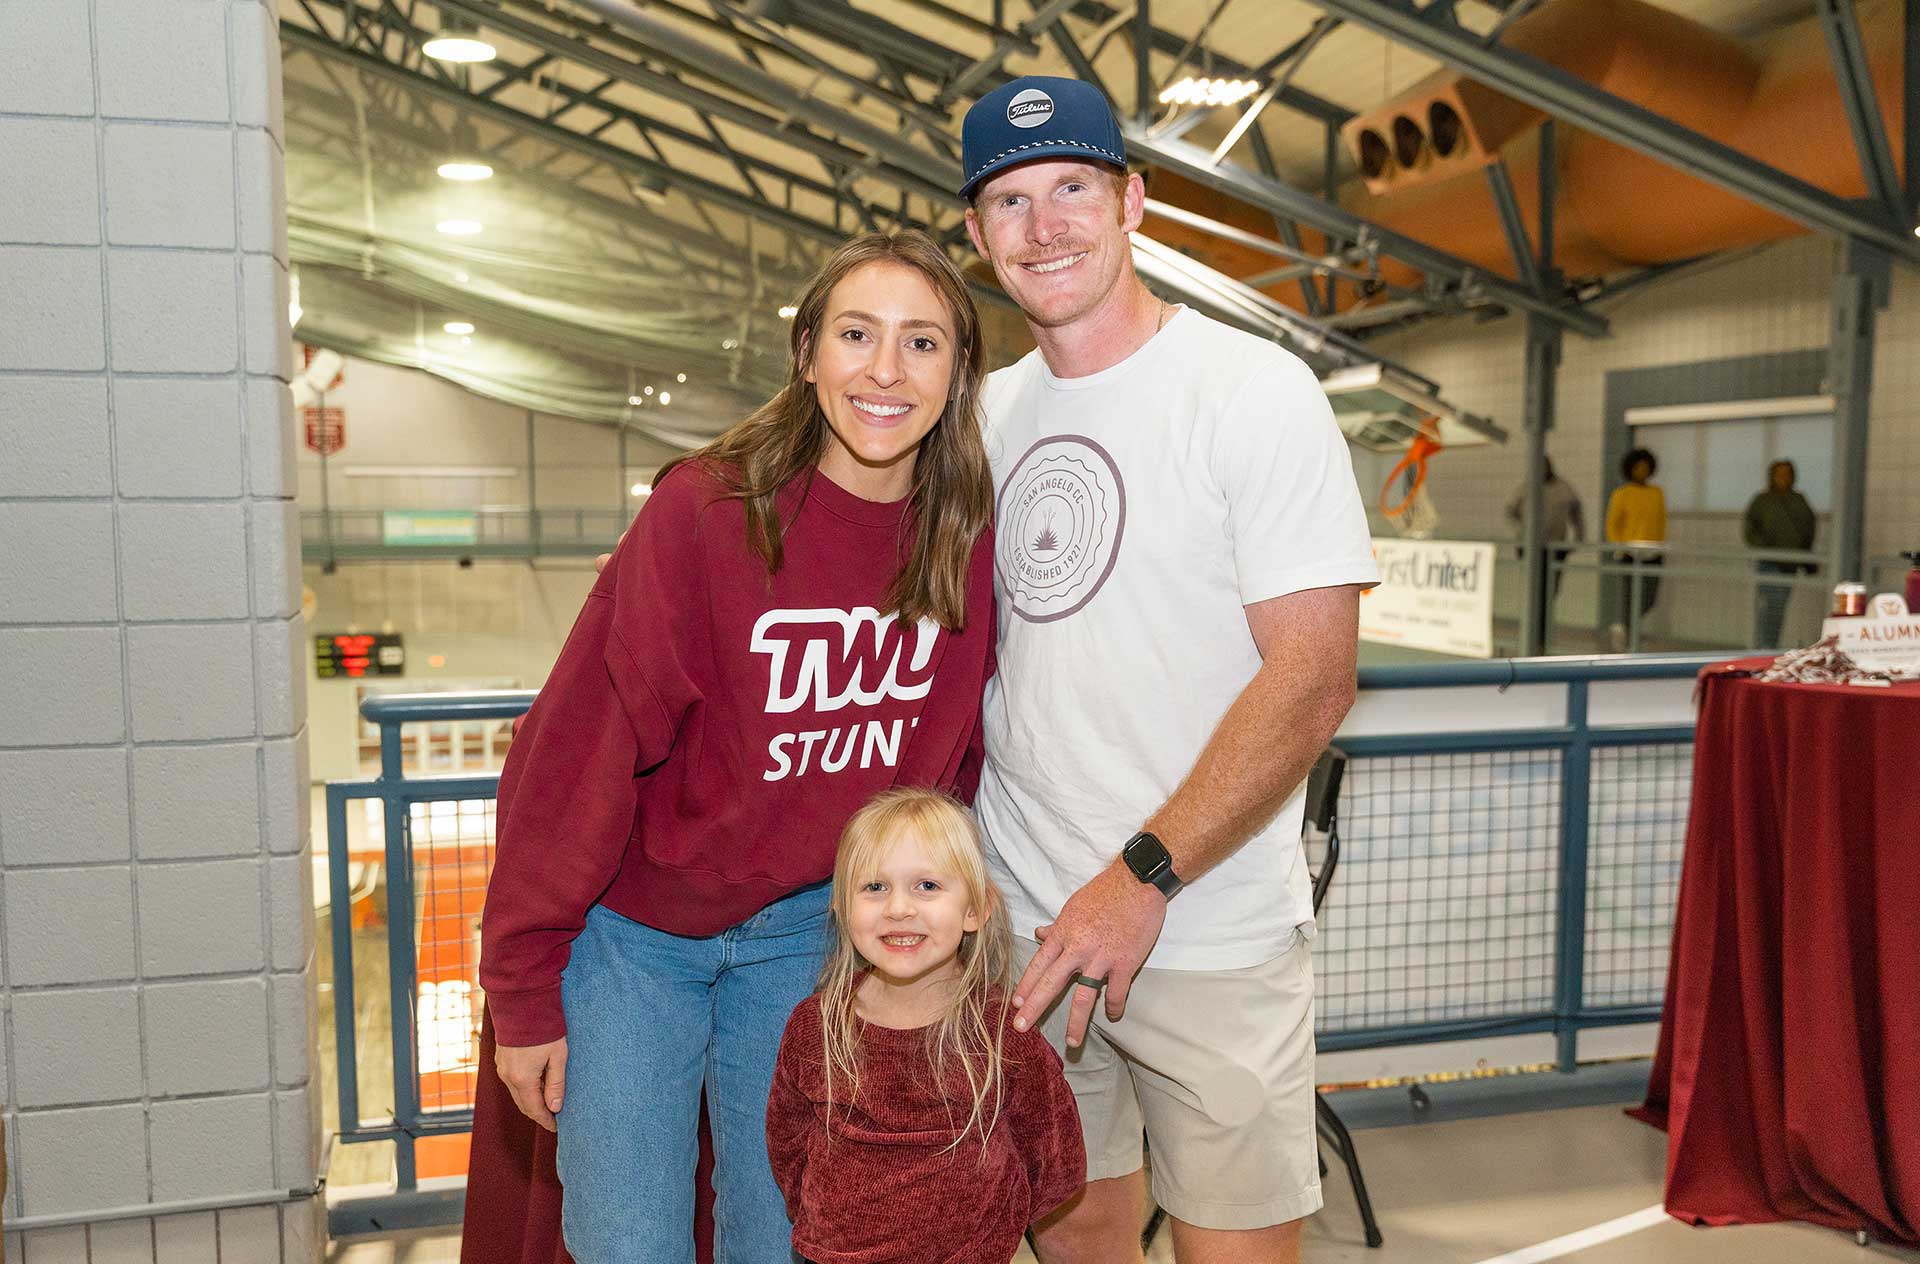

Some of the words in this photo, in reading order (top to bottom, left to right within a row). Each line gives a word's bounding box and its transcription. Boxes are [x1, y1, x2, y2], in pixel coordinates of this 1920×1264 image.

[1010, 103, 1051, 118] Titleist
[1023, 487, 1038, 507] SAN
[1039, 478, 1074, 493] ANGELO
[1072, 485, 1085, 505] CC
[1013, 546, 1062, 580] ESTABLISHED
[1063, 544, 1082, 570] 1927
[750, 606, 940, 713] TWU
[763, 717, 919, 782] STUN
